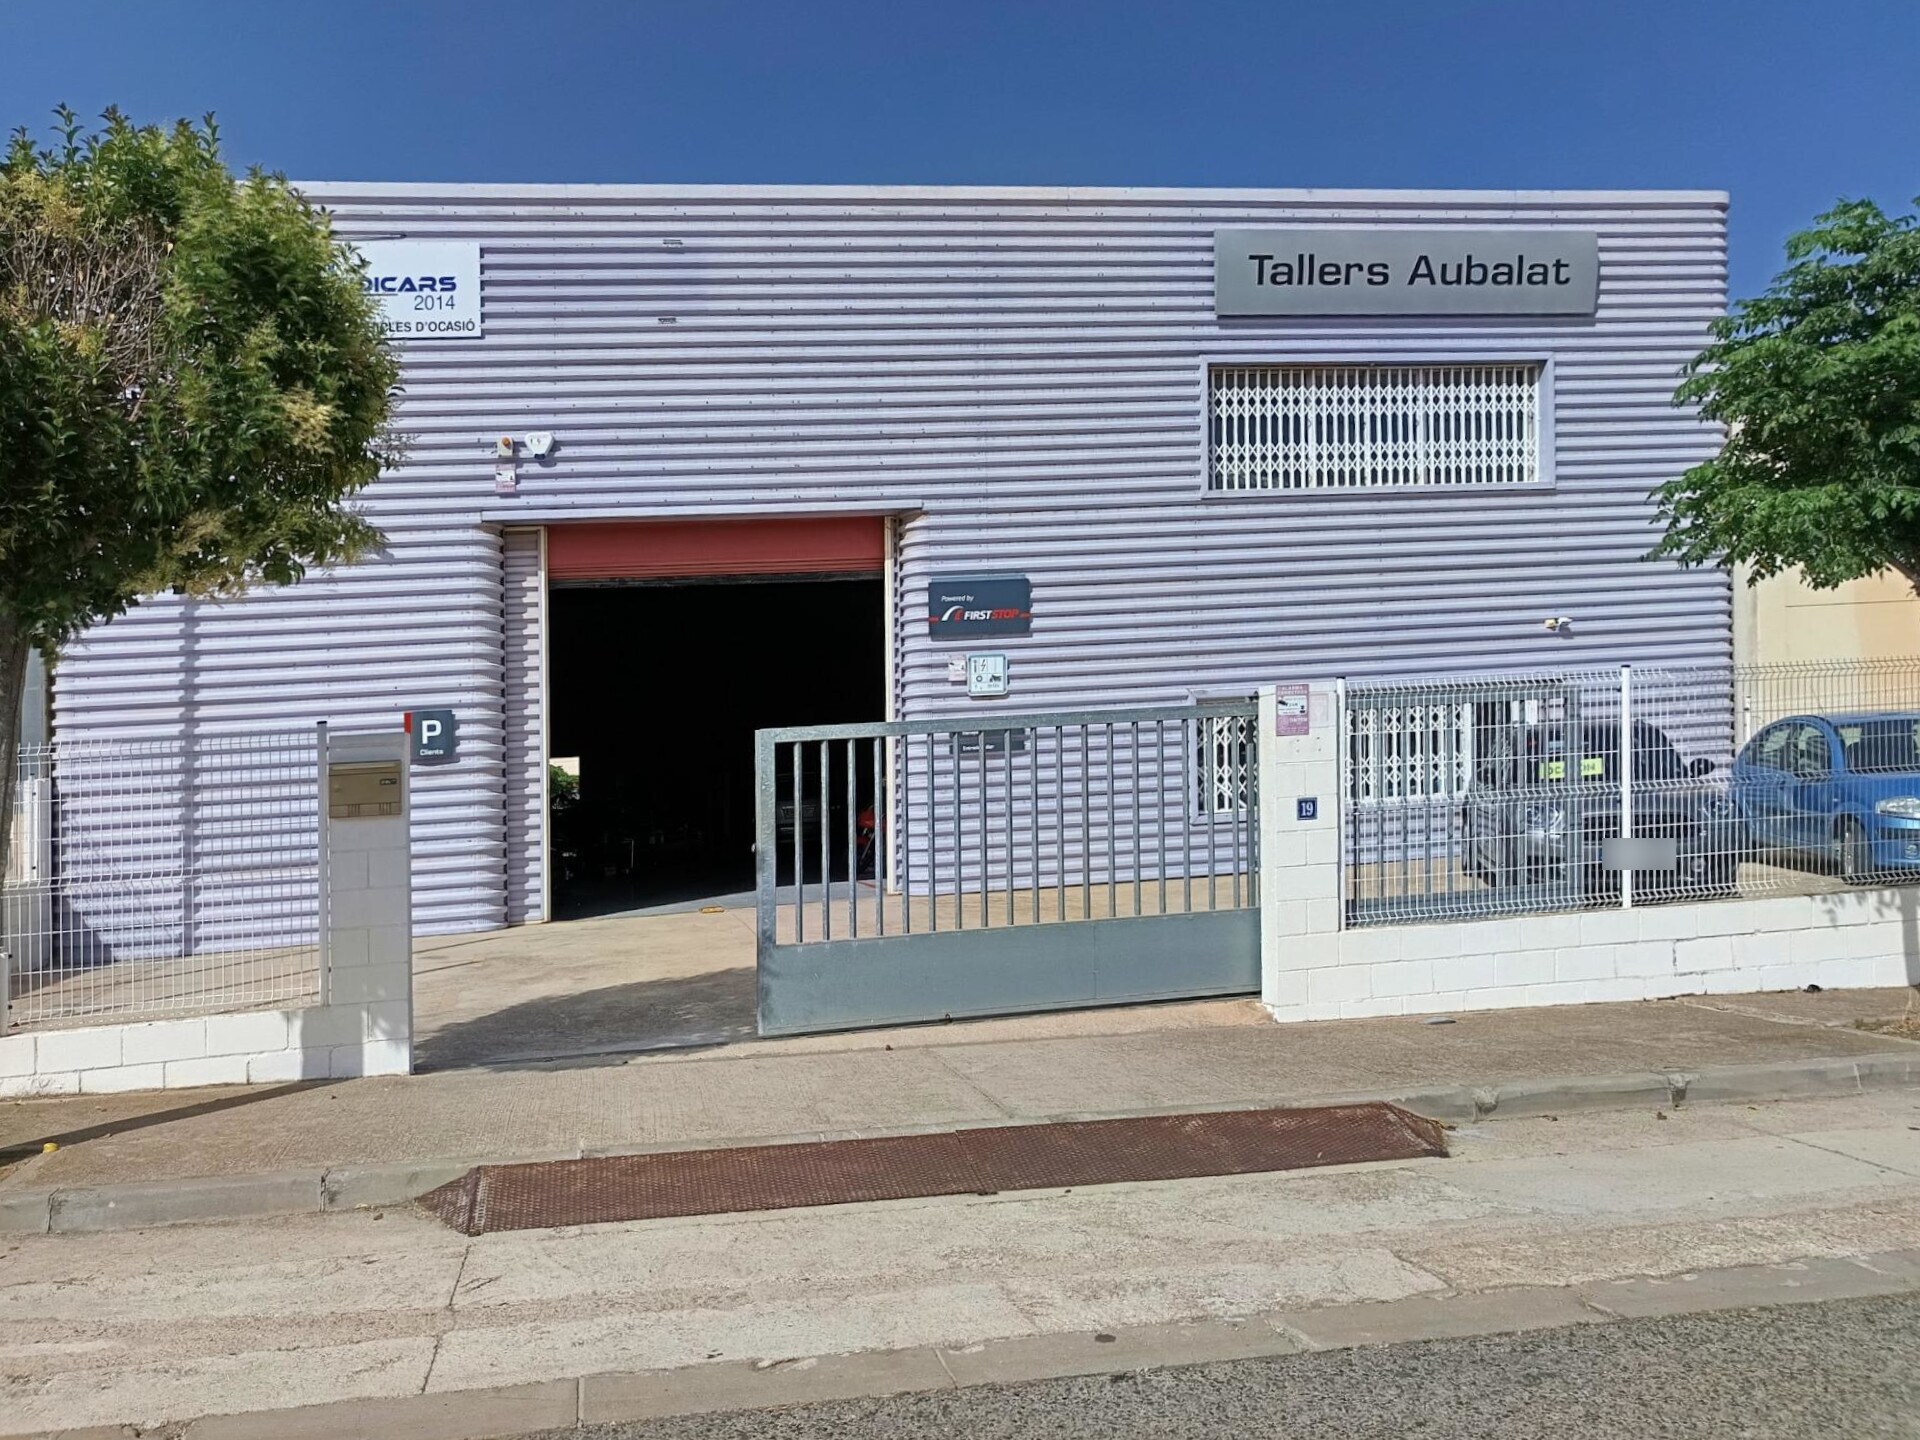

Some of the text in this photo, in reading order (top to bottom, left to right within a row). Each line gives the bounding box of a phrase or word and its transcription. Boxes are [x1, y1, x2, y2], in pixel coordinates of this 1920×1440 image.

[1248, 253, 1571, 286] Tallers Aubalat
[414, 294, 455, 310] 2014
[415, 318, 475, 332] D'OCASIÓ
[421, 719, 442, 744] P
[1300, 801, 1314, 816] 19
